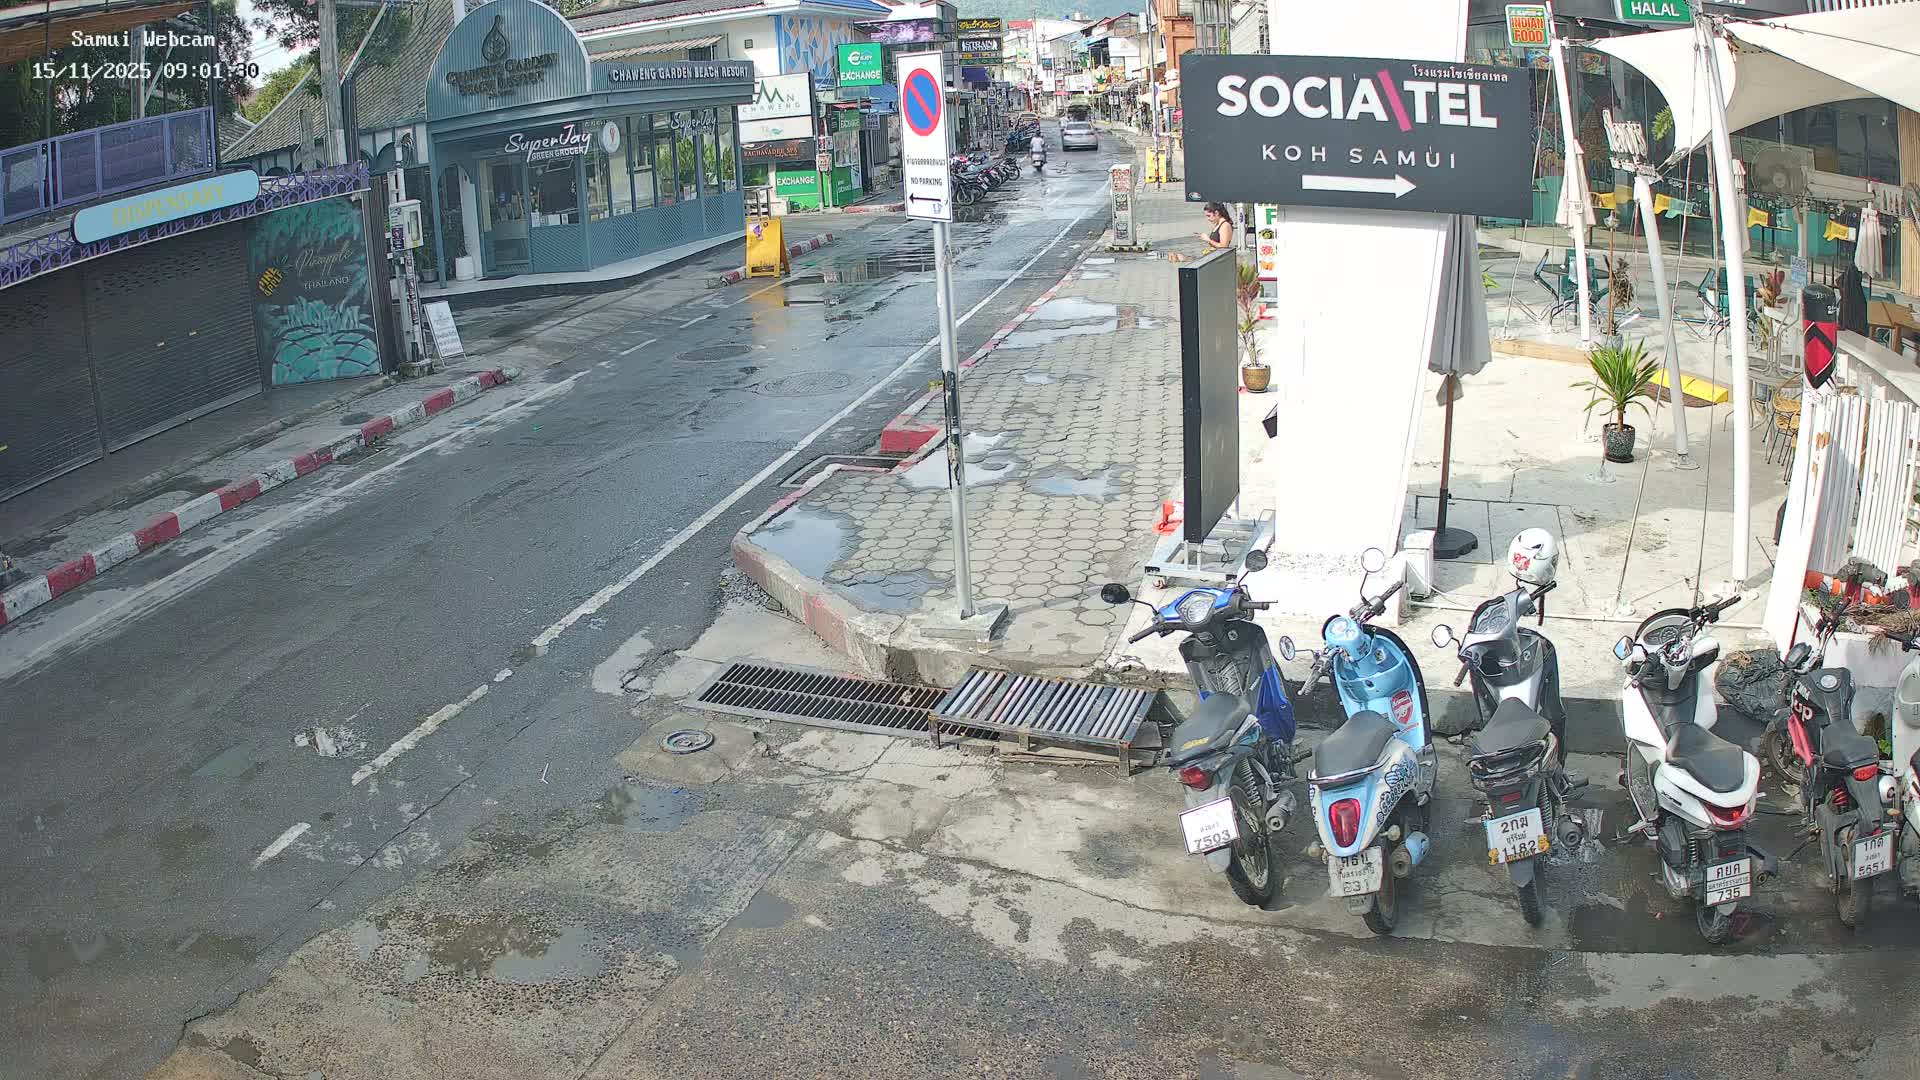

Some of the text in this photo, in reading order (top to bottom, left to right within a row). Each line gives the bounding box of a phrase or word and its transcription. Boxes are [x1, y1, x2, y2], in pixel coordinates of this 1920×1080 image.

[1632, 1, 1680, 17] HALAL
[1511, 16, 1545, 29] INDIAN
[1514, 29, 1544, 43] FOOD
[612, 65, 748, 81] CHAWENG GARDEN BEACH RESORT
[840, 70, 881, 81] EXCHANGE
[1411, 63, 1508, 83] โรงแรมโซเชียลเทล
[531, 151, 554, 160] GREEN
[1261, 144, 1456, 169] KOH SAMUI
[776, 176, 815, 186] EXCHANGE
[910, 177, 943, 187] NO PARKING
[112, 183, 226, 228] DISPENSARY
[304, 276, 350, 290] THAILAND
[1193, 829, 1231, 851] 7503
[1502, 840, 1536, 859] 1182
[1716, 887, 1741, 902] 735
